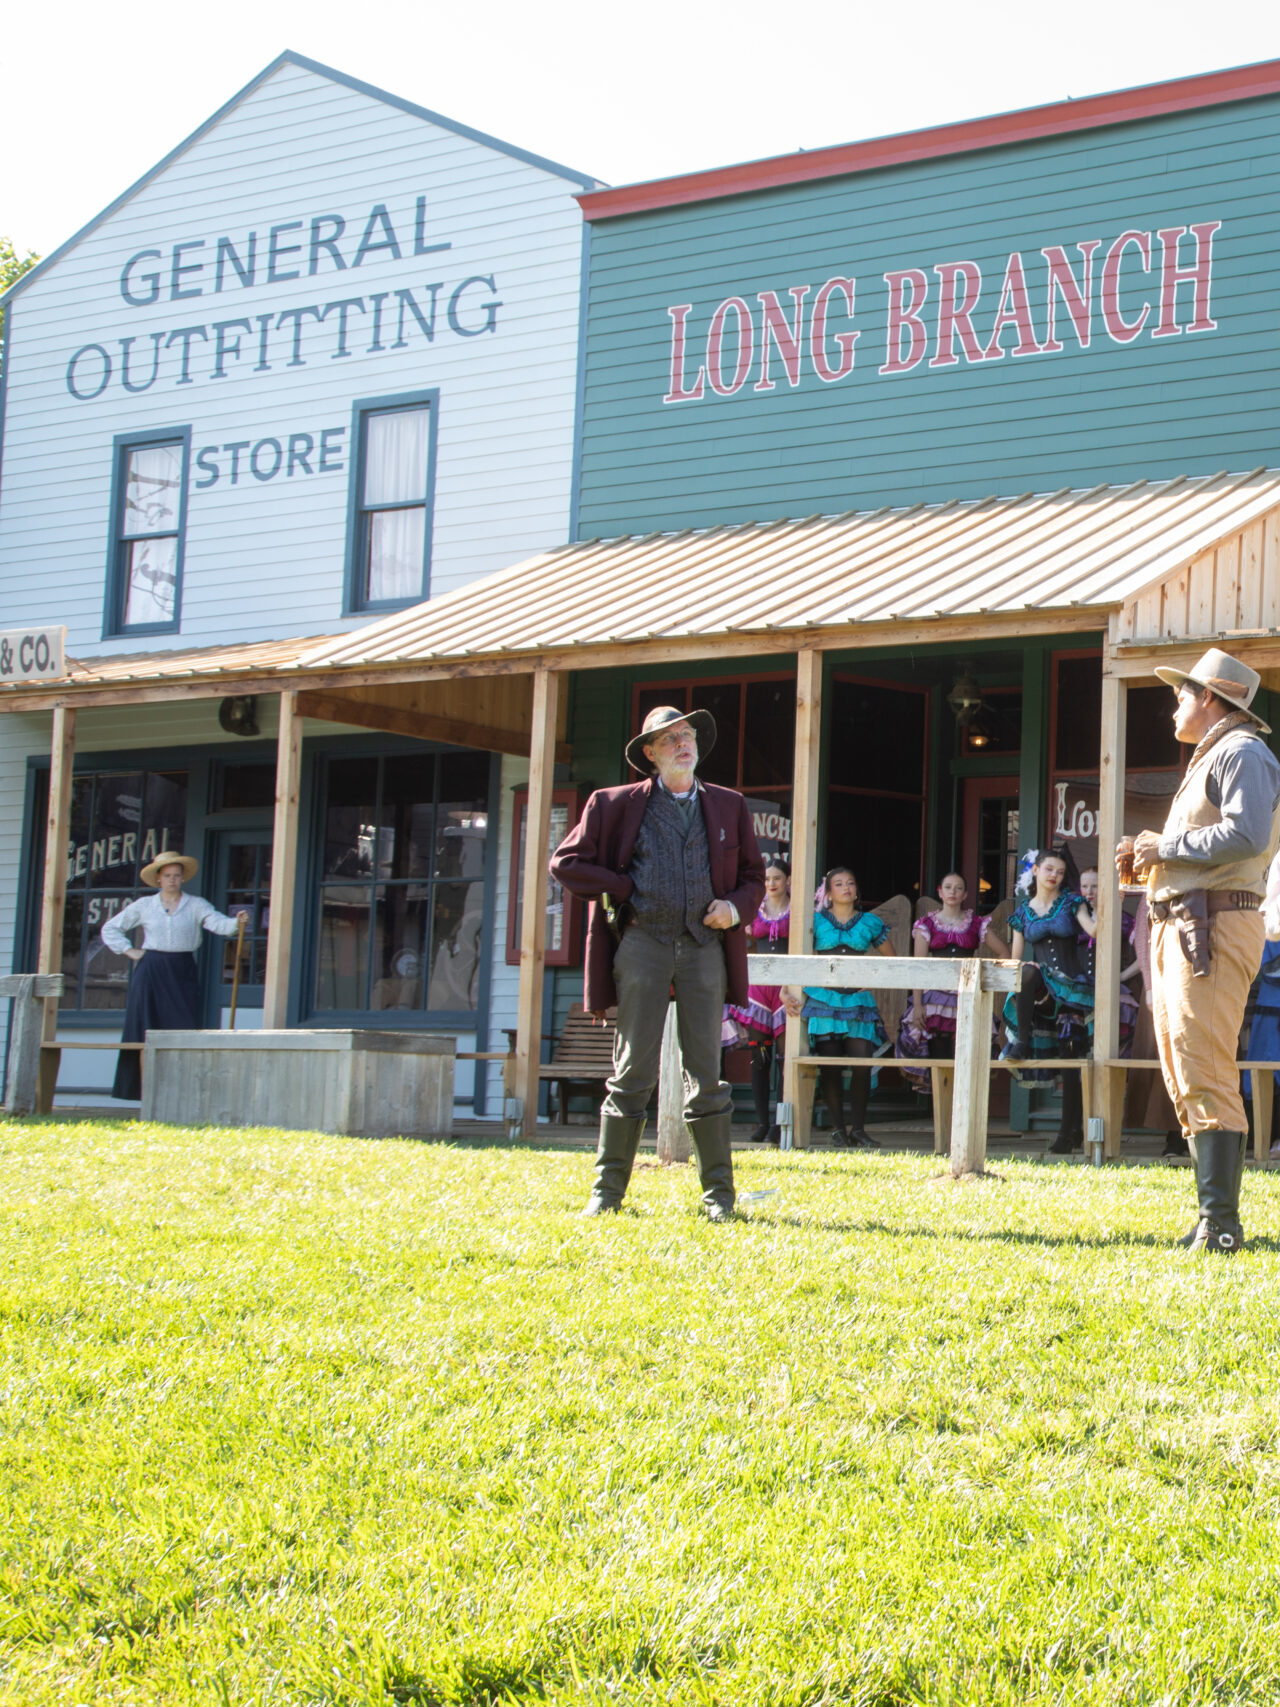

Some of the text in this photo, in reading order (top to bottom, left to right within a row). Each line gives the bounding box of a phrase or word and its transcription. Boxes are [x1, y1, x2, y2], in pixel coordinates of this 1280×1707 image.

[120, 195, 452, 307] GENERAL
[66, 273, 504, 401] OUTFITTING
[662, 220, 1222, 404] LONG BRANCH
[195, 426, 346, 489] STORE
[0, 633, 55, 676] & CO.
